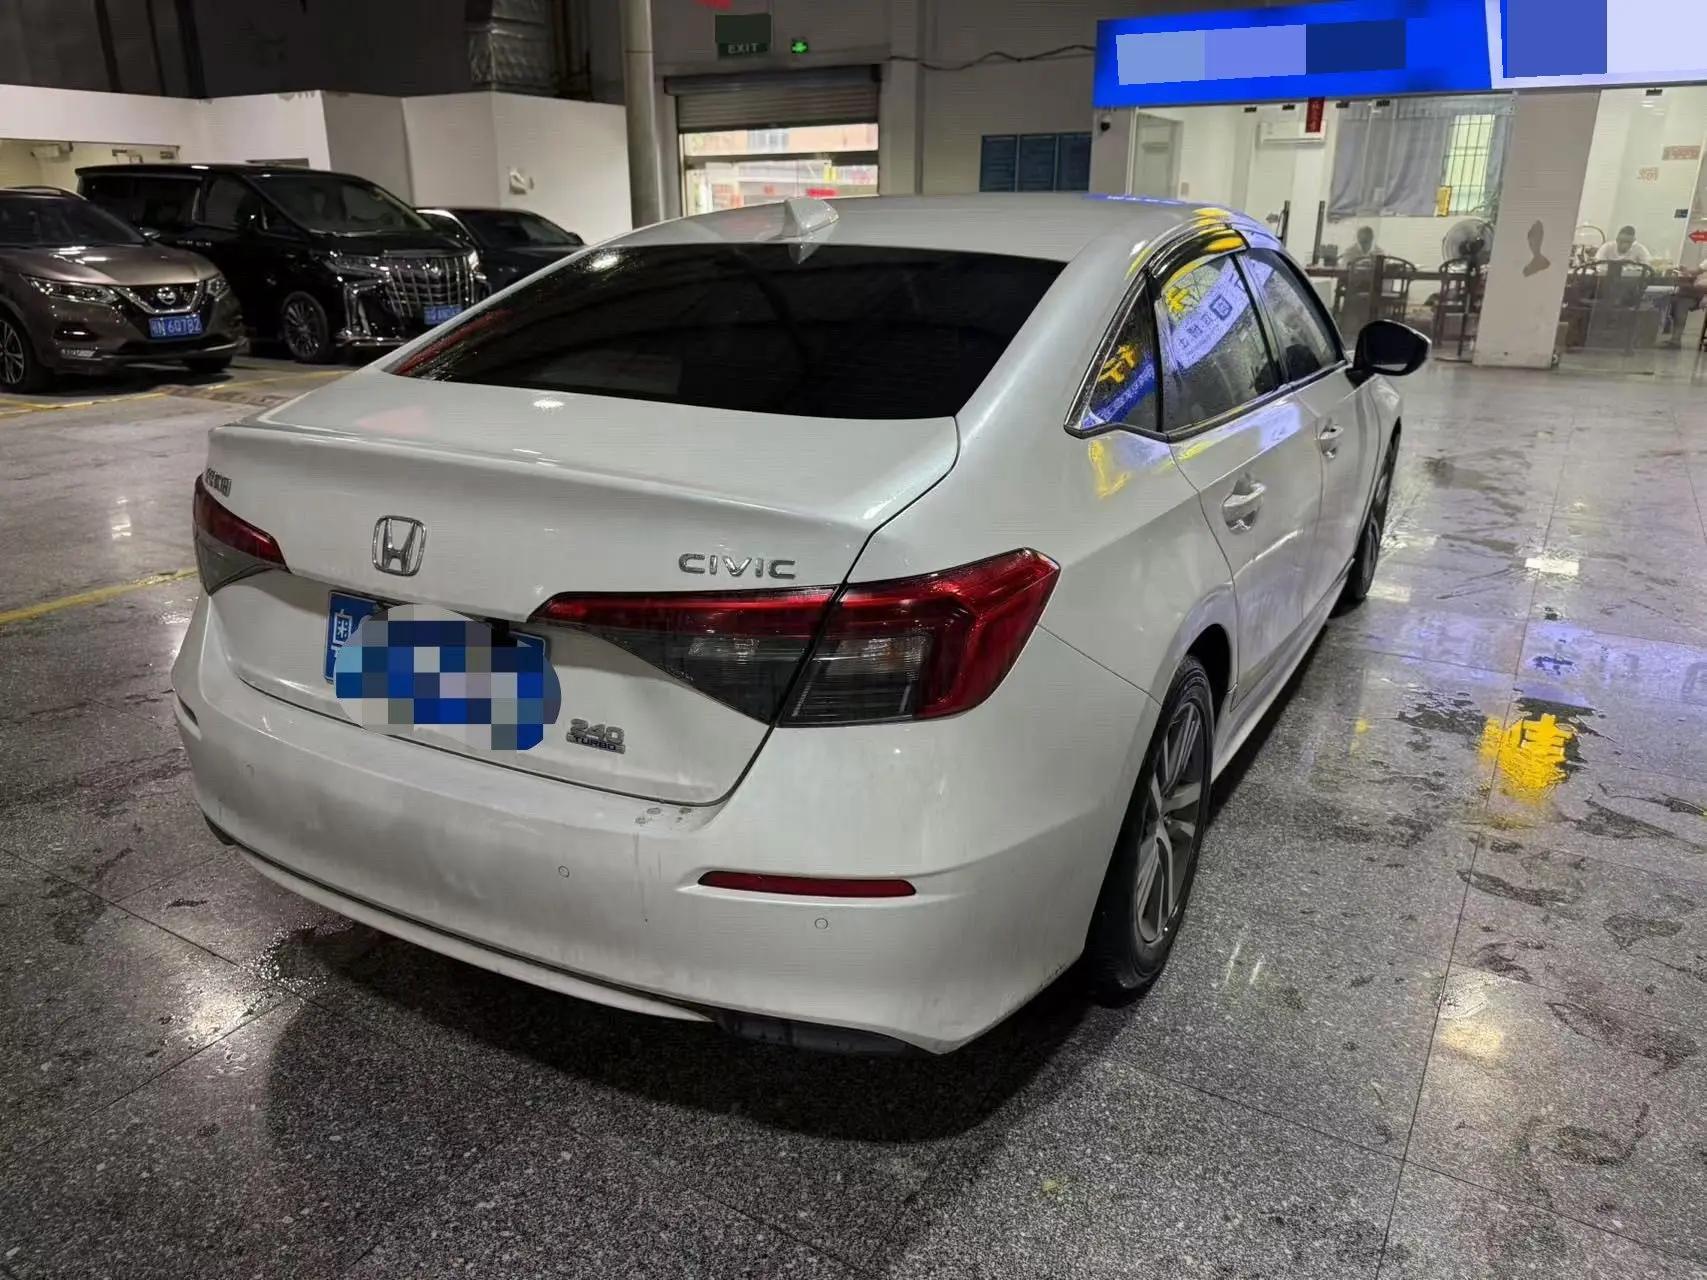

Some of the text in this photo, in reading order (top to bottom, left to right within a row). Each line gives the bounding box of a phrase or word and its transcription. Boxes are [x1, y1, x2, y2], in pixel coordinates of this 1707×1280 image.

[727, 43, 760, 55] EXIT
[678, 552, 796, 580] CIVIC
[570, 718, 625, 745] 240
[575, 737, 616, 752] TURBO
